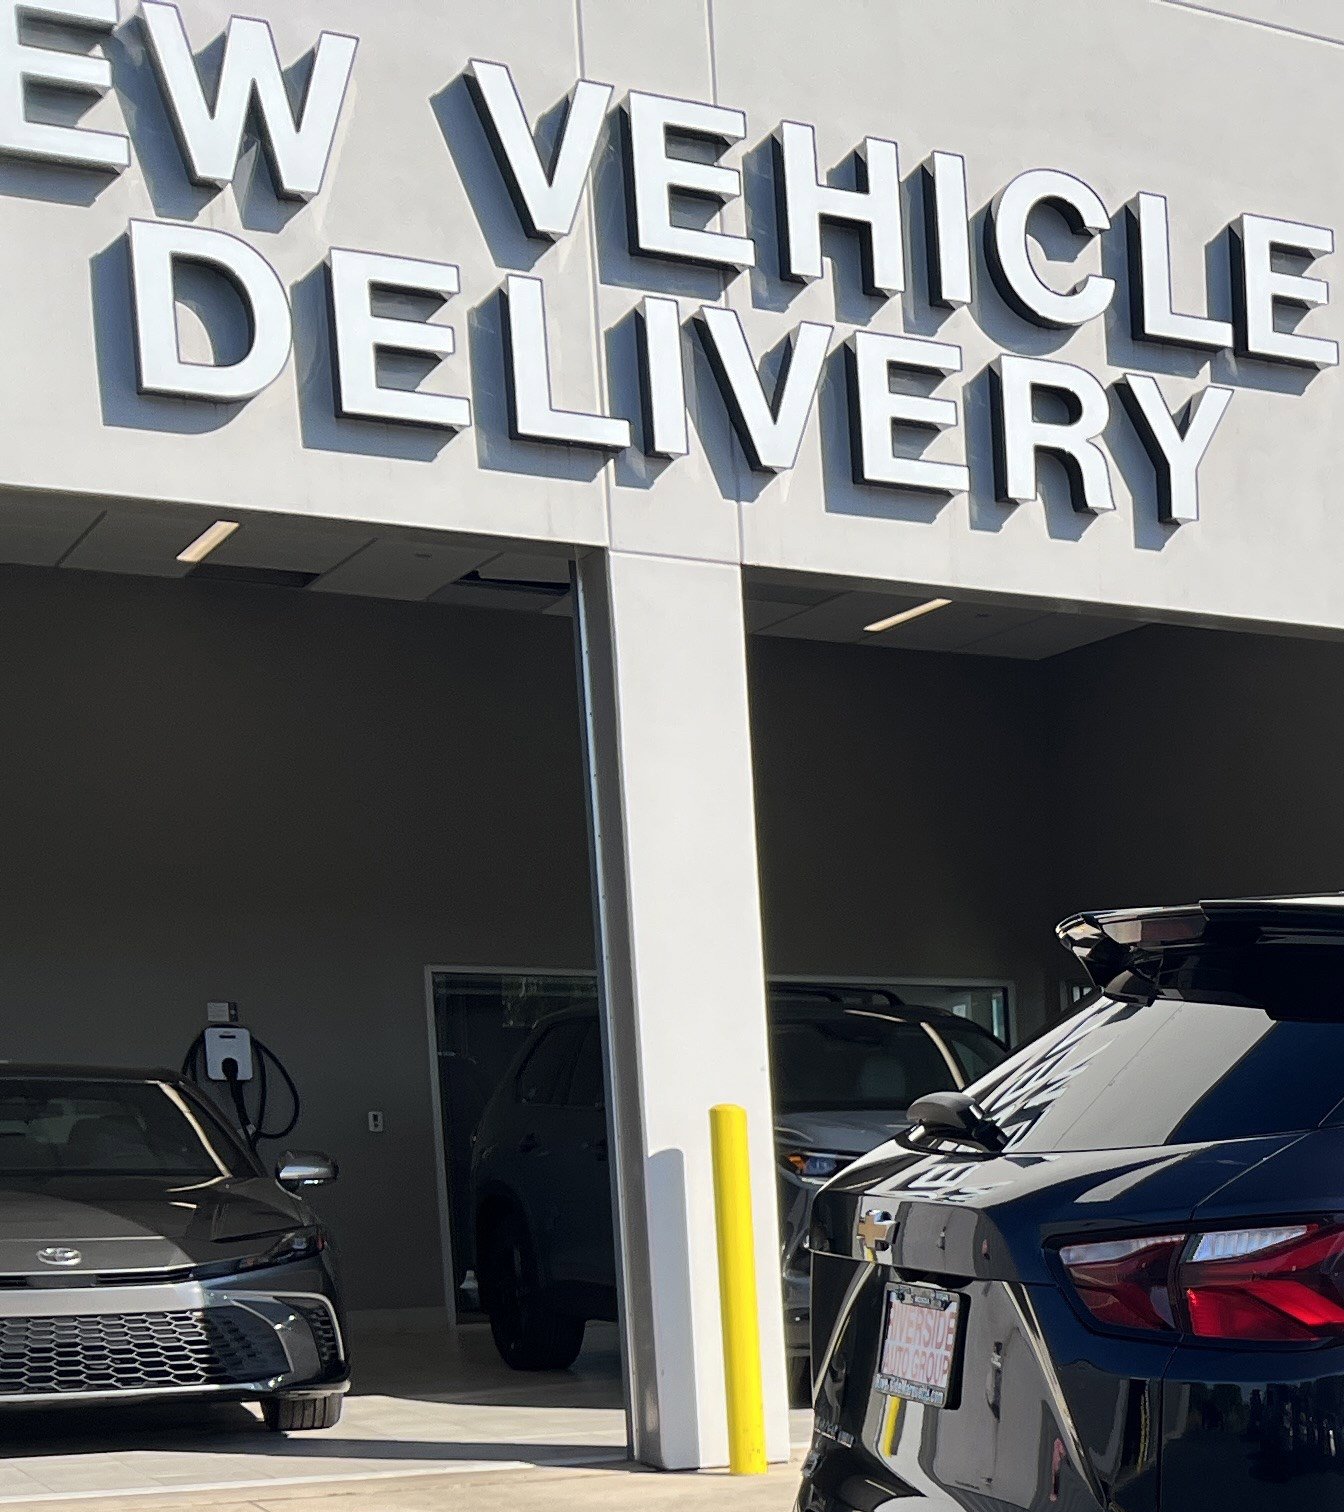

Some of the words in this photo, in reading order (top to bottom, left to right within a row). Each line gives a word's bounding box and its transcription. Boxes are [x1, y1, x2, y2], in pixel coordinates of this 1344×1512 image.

[467, 57, 1340, 367] VEHICLE
[127, 217, 1235, 525] DELIVERY
[887, 1302, 957, 1351] RIVERSIDE
